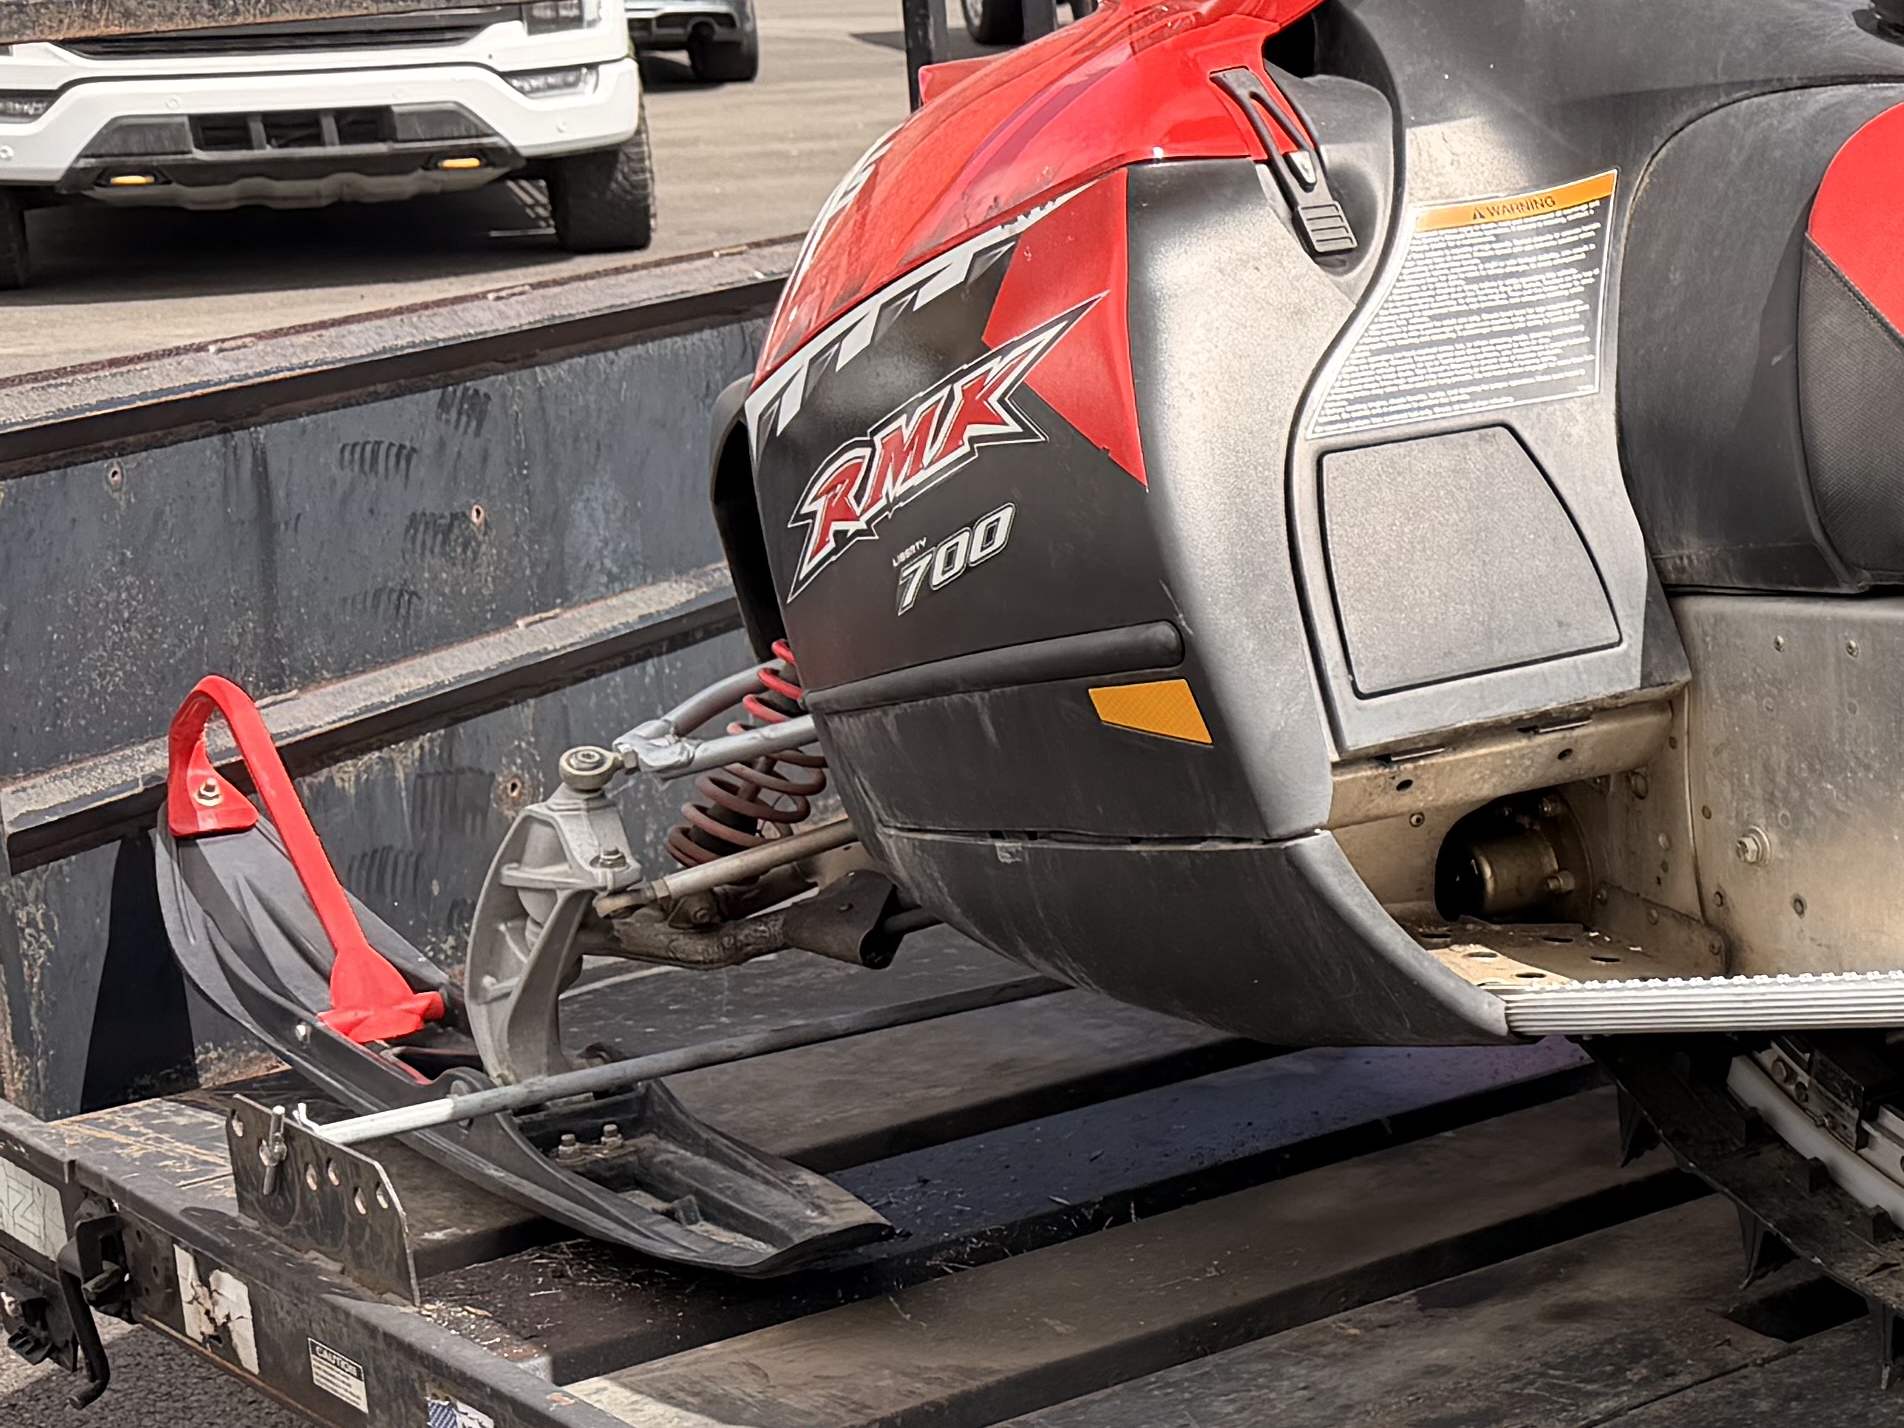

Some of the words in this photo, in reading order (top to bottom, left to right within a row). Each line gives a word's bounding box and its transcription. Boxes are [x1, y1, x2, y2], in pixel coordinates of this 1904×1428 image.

[1484, 195, 1557, 220] WARNING
[797, 314, 1075, 584] RMK
[898, 503, 1016, 615] 700
